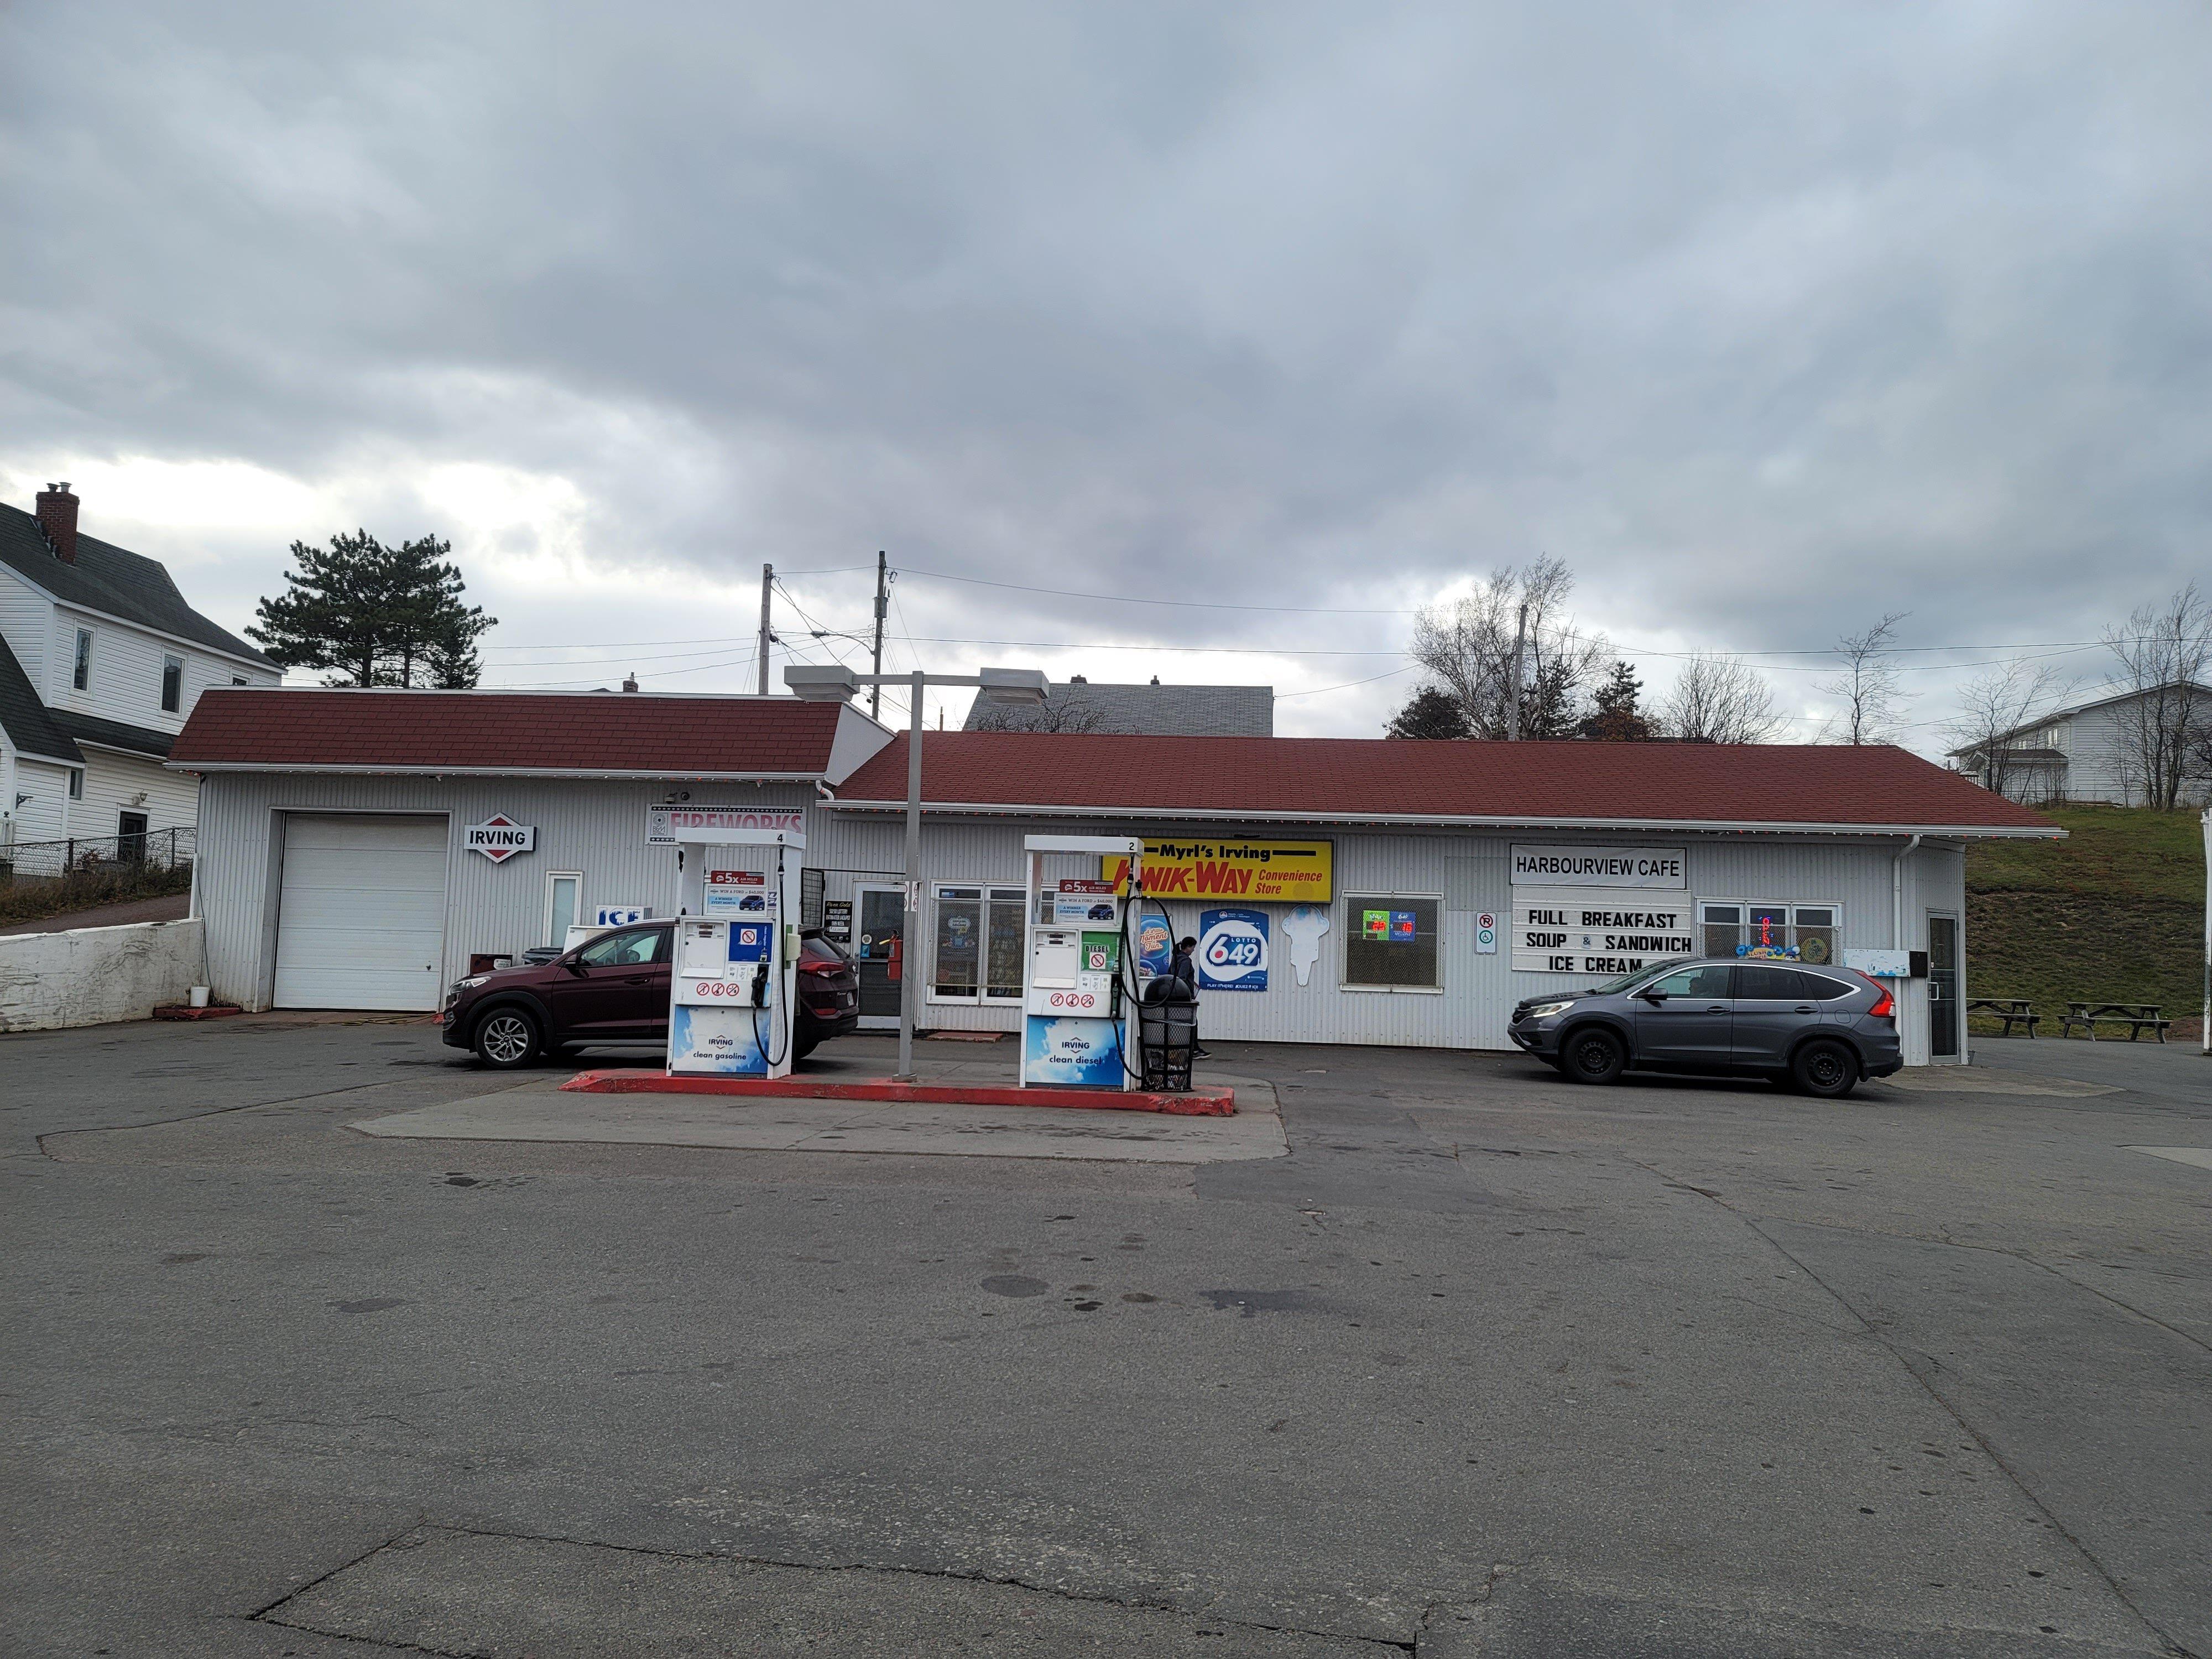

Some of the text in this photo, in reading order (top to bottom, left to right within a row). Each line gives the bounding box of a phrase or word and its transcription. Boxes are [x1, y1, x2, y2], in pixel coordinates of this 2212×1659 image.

[670, 813, 802, 834] FIREWORKS
[469, 830, 525, 845] IRVING
[777, 833, 783, 842] 4
[1129, 842, 1134, 851] 2
[1160, 844, 1271, 862] Myrl's Irving
[1517, 856, 1679, 877] HARBOURVIEW CAFE
[725, 873, 739, 883] 5x
[1258, 869, 1323, 881] Convenience
[1073, 881, 1088, 893] 5x
[1255, 882, 1281, 895] Store
[598, 907, 640, 926] ICE
[1529, 910, 1677, 928] FULL BREAKFAST
[1526, 932, 1692, 952] SOUP & SANDWICH
[1550, 956, 1642, 973] ICE CREAM
[1049, 1055, 1102, 1065] clean diesel
